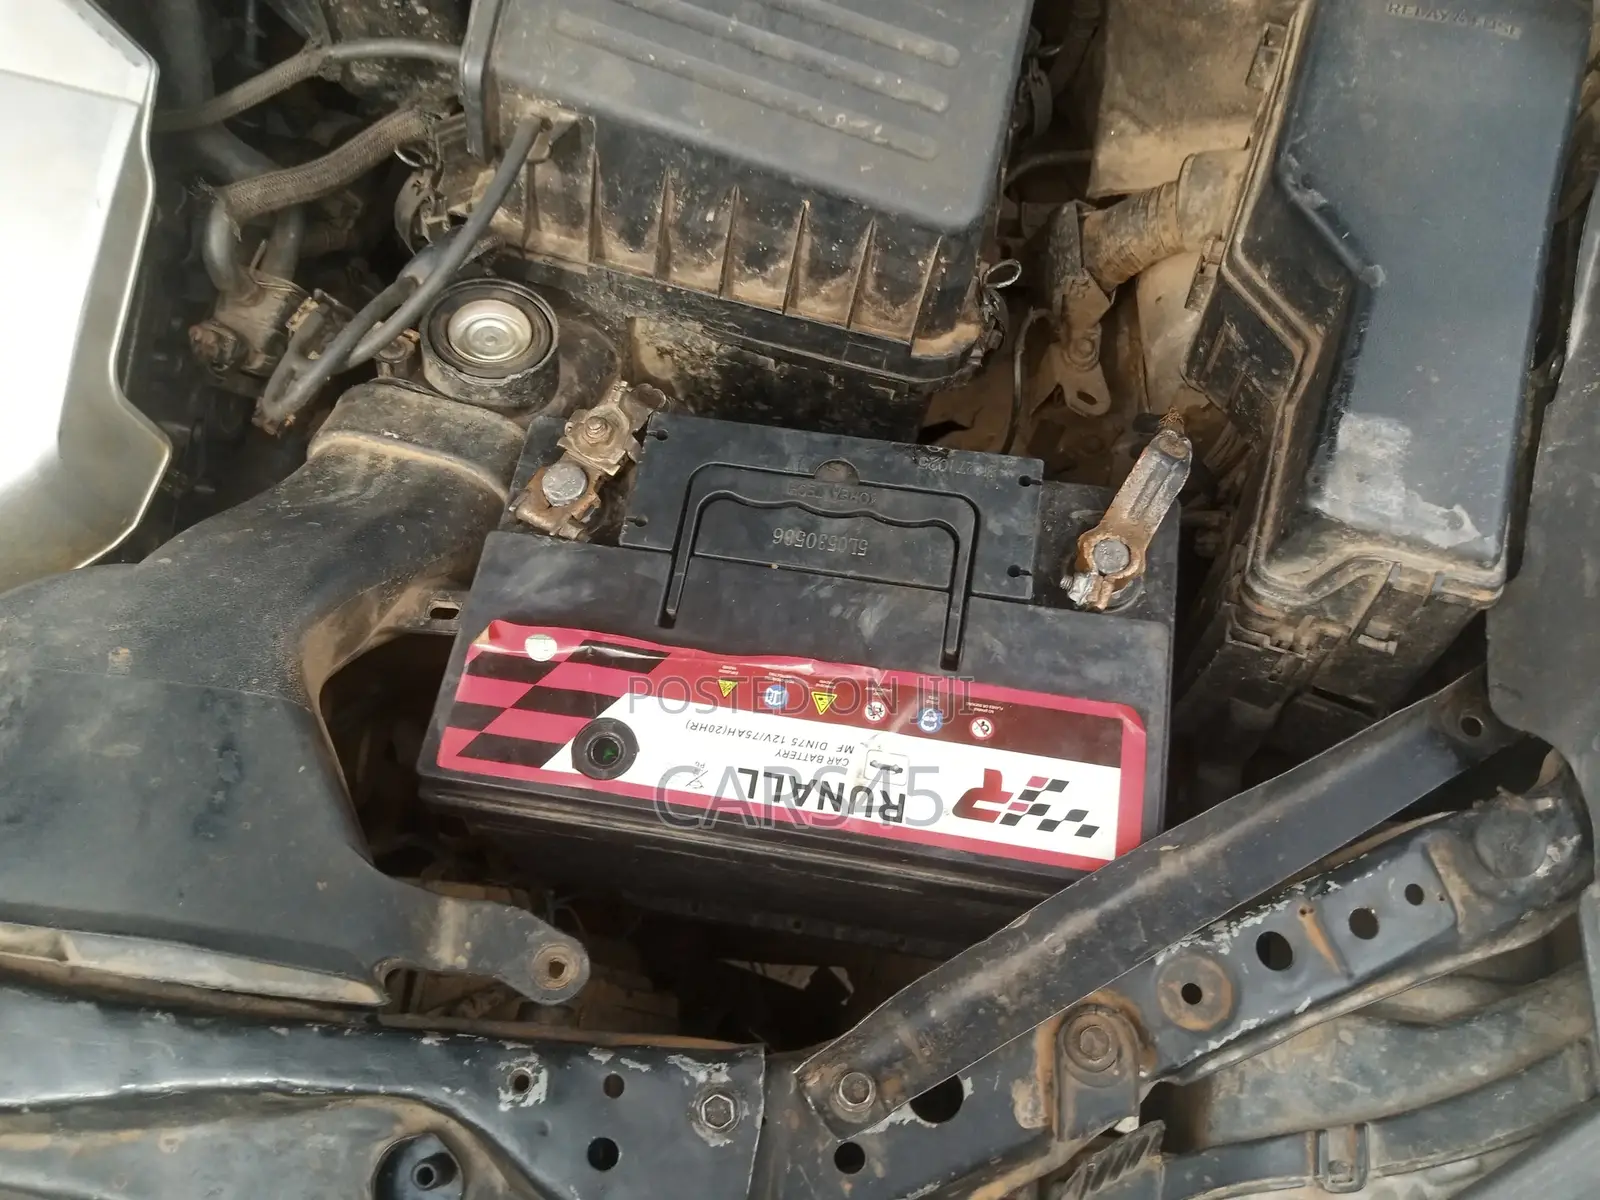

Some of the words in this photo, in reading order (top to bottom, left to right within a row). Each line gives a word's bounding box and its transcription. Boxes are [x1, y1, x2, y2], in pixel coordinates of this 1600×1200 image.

[1387, 2, 1449, 22] RELAY
[685, 719, 786, 744] 12V/75AH(20HR)
[791, 737, 829, 751] DIN75
[836, 743, 855, 754] MF
[775, 748, 825, 764] BATTERY
[827, 756, 850, 767] CAR
[737, 767, 906, 823] RUNALL
